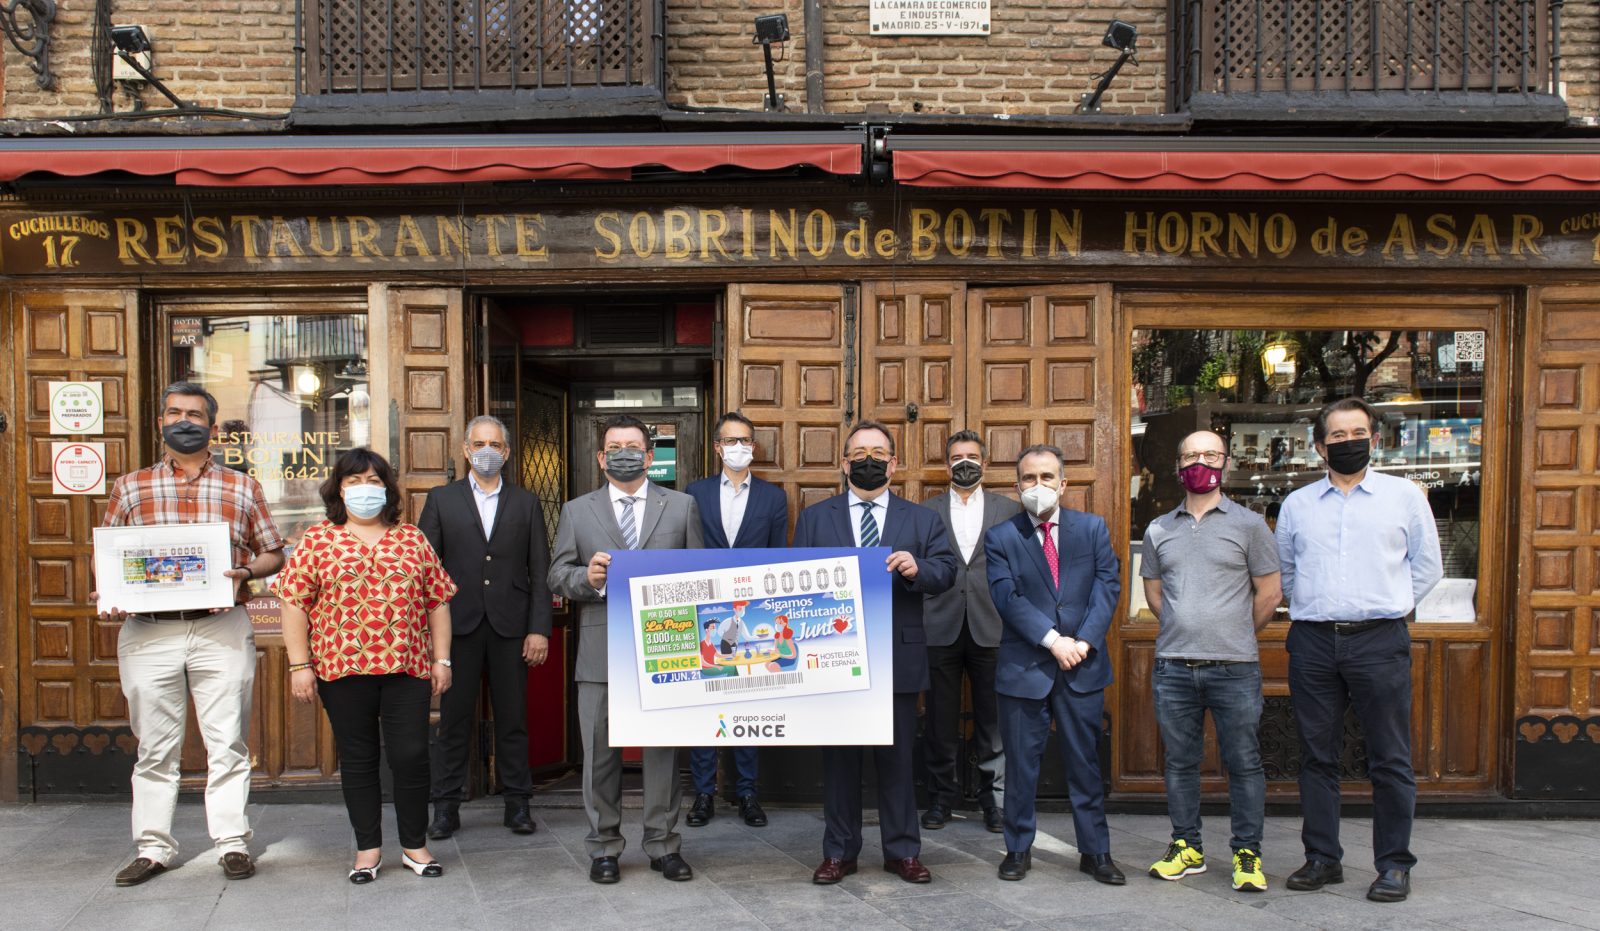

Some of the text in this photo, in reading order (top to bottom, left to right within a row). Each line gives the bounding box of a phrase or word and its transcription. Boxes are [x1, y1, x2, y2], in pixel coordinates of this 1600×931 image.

[874, 1, 886, 9] LA
[927, 1, 938, 9] DE
[940, 1, 987, 9] COMERCIO
[900, 11, 906, 19] E
[9, 214, 111, 241] CUCHILLEROS
[113, 207, 1548, 265] RESTAURANTE SOBRINO de BOTIN HORNO de ASAR
[180, 335, 196, 344] AR
[224, 448, 324, 465] BOTIN
[734, 576, 752, 584] SERIE
[764, 598, 814, 613] Sigamos
[785, 604, 854, 620] disfrutando
[645, 618, 694, 632] La Paga
[646, 632, 670, 644] 3.000
[648, 645, 672, 654] DURANTE
[660, 658, 698, 669] ONCE
[658, 670, 701, 682] 17 JUN. 21
[733, 715, 759, 723] grupo
[733, 725, 785, 737] ONCE
